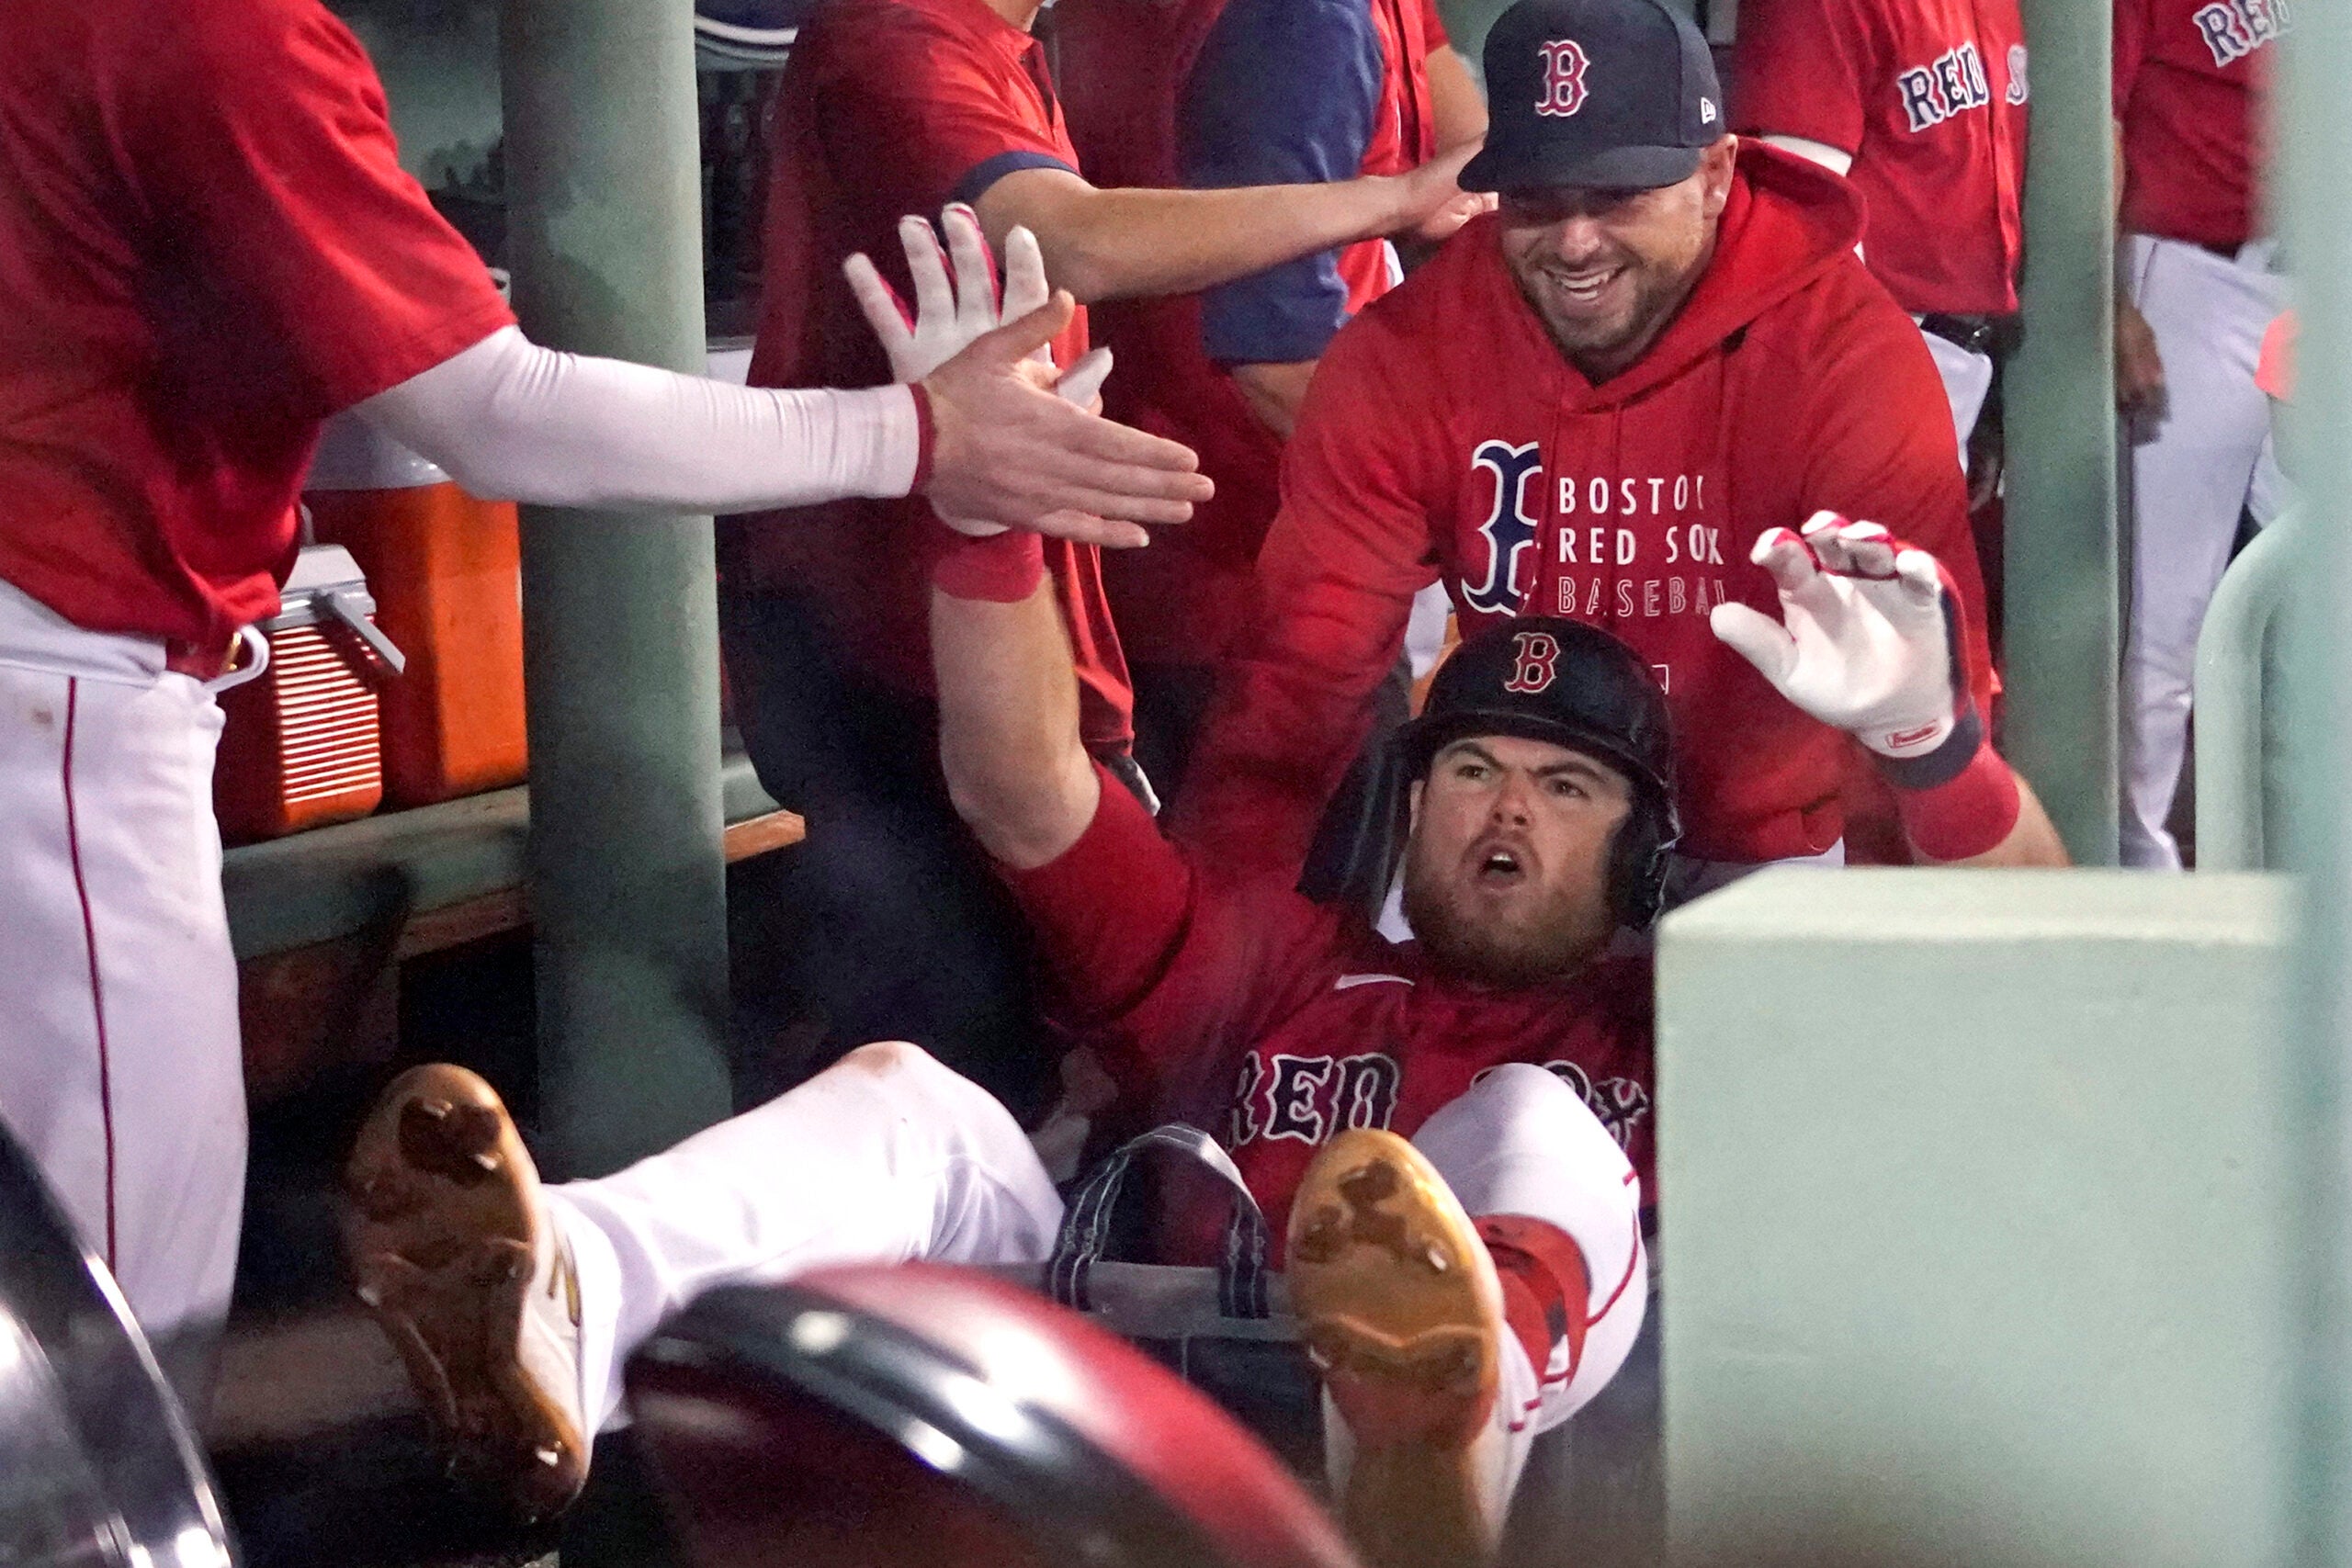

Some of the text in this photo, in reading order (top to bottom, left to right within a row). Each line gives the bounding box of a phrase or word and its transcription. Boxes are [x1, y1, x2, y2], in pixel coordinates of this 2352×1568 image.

[1535, 39, 1590, 117] B
[1897, 41, 1990, 133] RED
[1559, 524, 1724, 565] RED SOX
[1504, 632, 1561, 694] B
